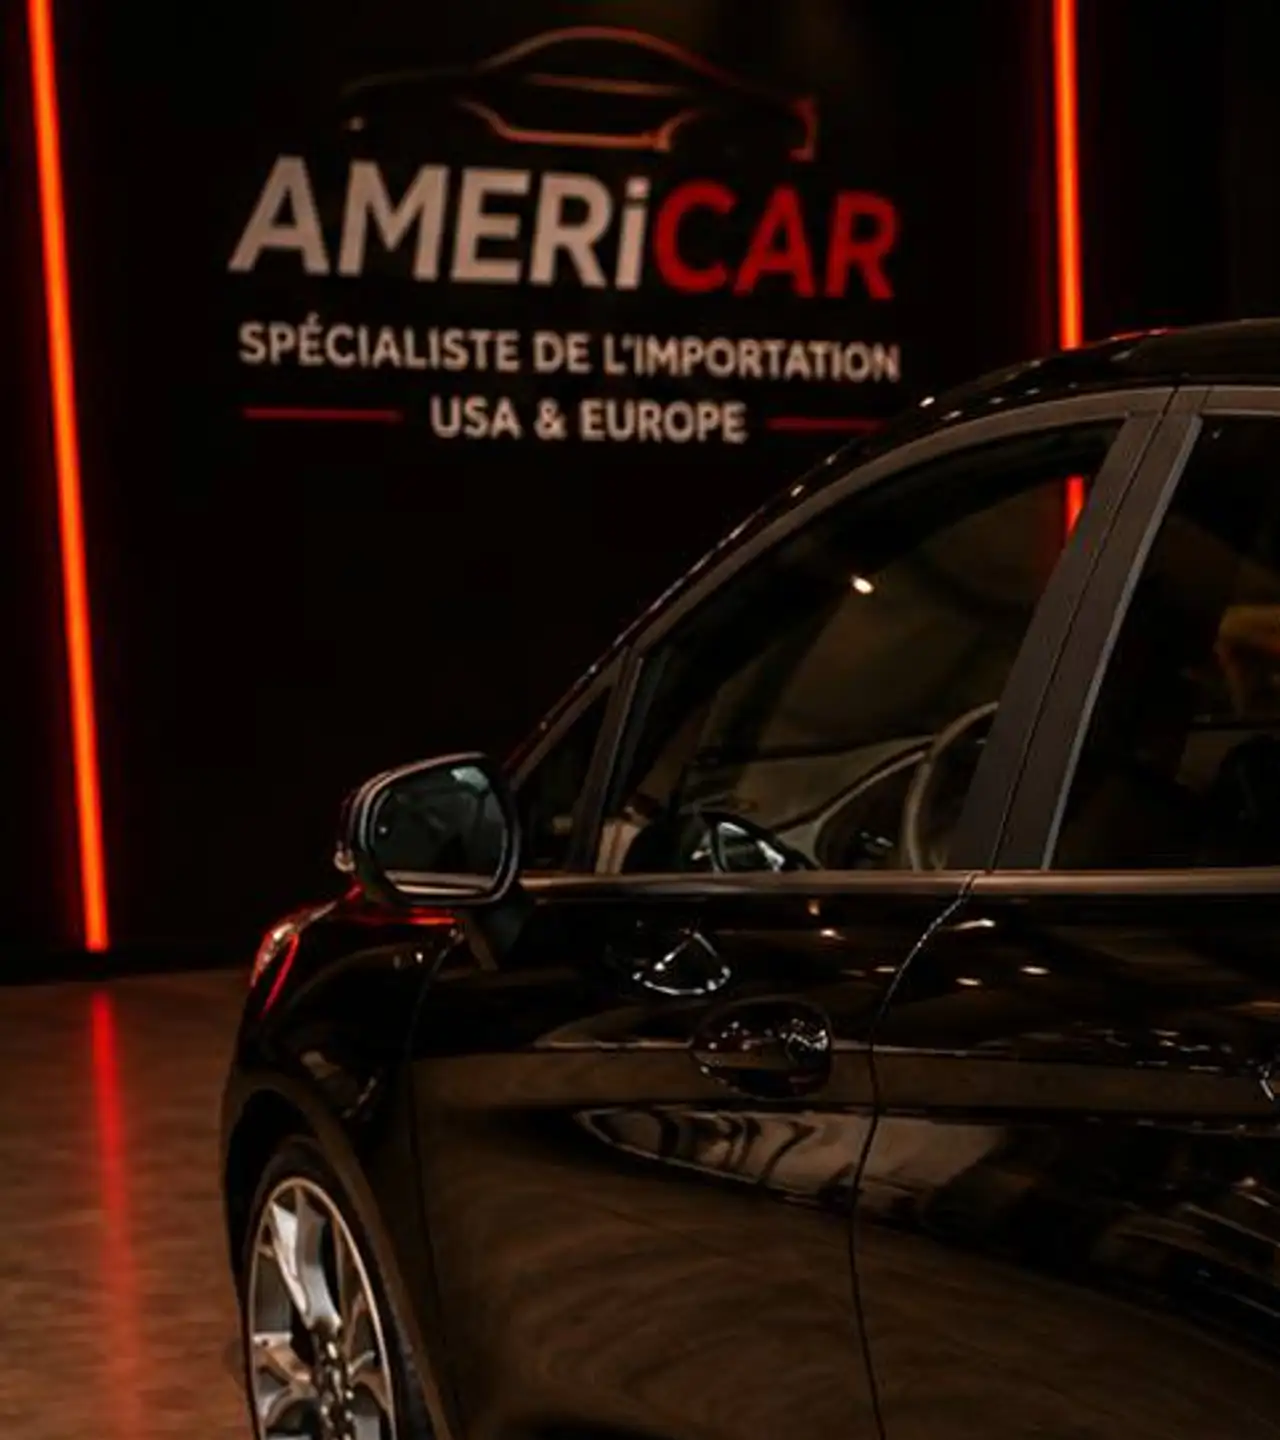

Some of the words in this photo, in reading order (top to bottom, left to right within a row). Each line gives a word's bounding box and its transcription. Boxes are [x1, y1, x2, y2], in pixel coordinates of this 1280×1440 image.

[239, 313, 520, 373] SPÉCIALISTE
[533, 331, 591, 374] DE
[603, 334, 900, 381] L'IMPORTATION
[430, 395, 521, 439] USA
[534, 399, 566, 440] &
[579, 399, 746, 443] EUROPE
